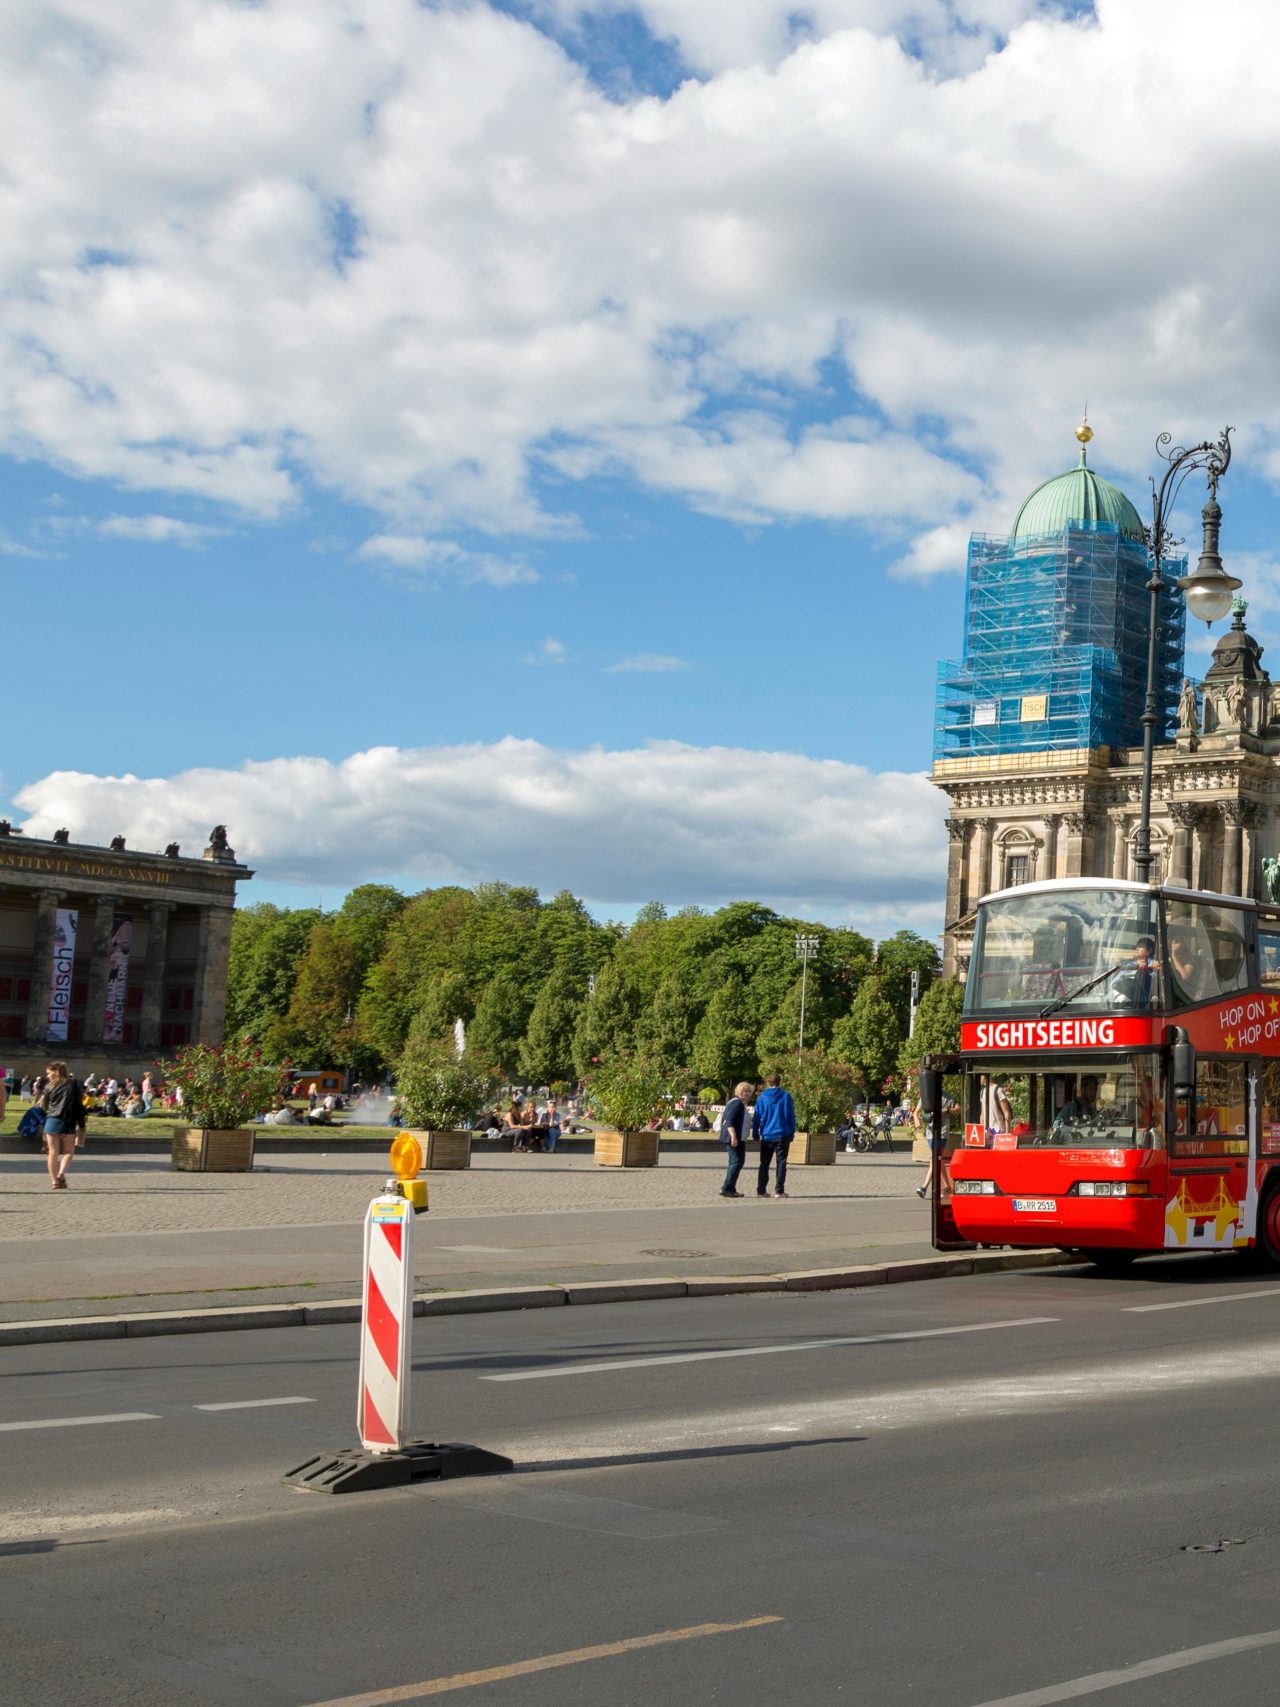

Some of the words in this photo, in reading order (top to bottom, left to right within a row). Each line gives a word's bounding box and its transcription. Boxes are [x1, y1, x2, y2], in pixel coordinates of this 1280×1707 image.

[1023, 704, 1045, 712] TISCH
[48, 947, 73, 1024] Fleisch
[106, 978, 117, 1012] NEUE
[112, 960, 129, 1033] NACHBARN
[1220, 1006, 1244, 1030] HOP
[1247, 1000, 1265, 1020] ON
[976, 1020, 1114, 1048] SIGHTSEEING
[1238, 1024, 1261, 1048] HOP
[969, 1125, 980, 1142] A
[1017, 1201, 1023, 1210] B
[1026, 1201, 1037, 1210] RR
[1037, 1201, 1056, 1211] 2515
